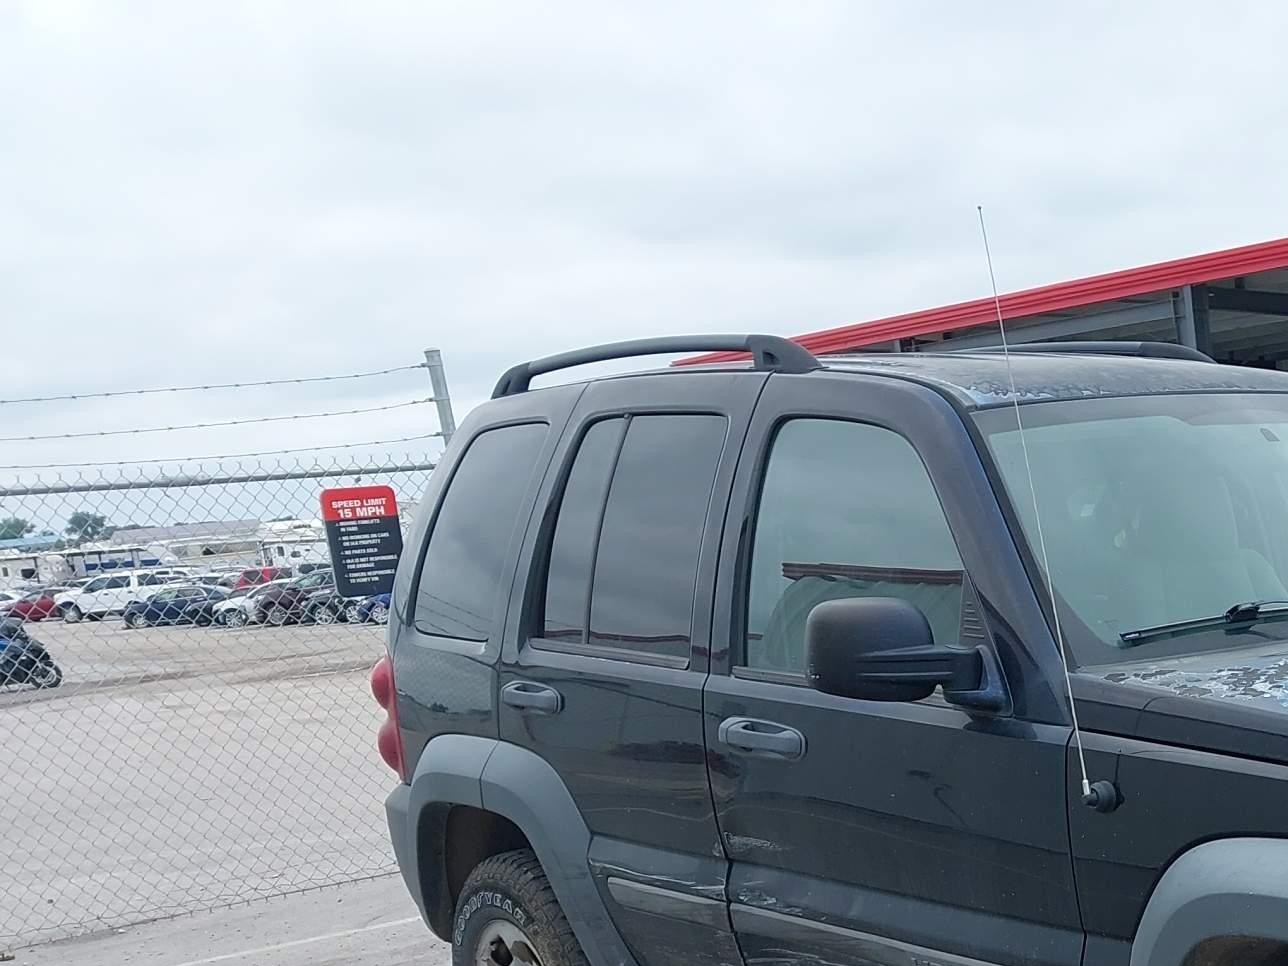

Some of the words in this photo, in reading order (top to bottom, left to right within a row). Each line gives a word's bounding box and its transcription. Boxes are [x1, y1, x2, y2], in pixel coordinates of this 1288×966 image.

[331, 500, 361, 508] SPEED
[363, 498, 387, 506] LIMIT
[337, 508, 352, 518] 15
[356, 505, 385, 517] MPH
[455, 891, 526, 946] GOODYEAR
